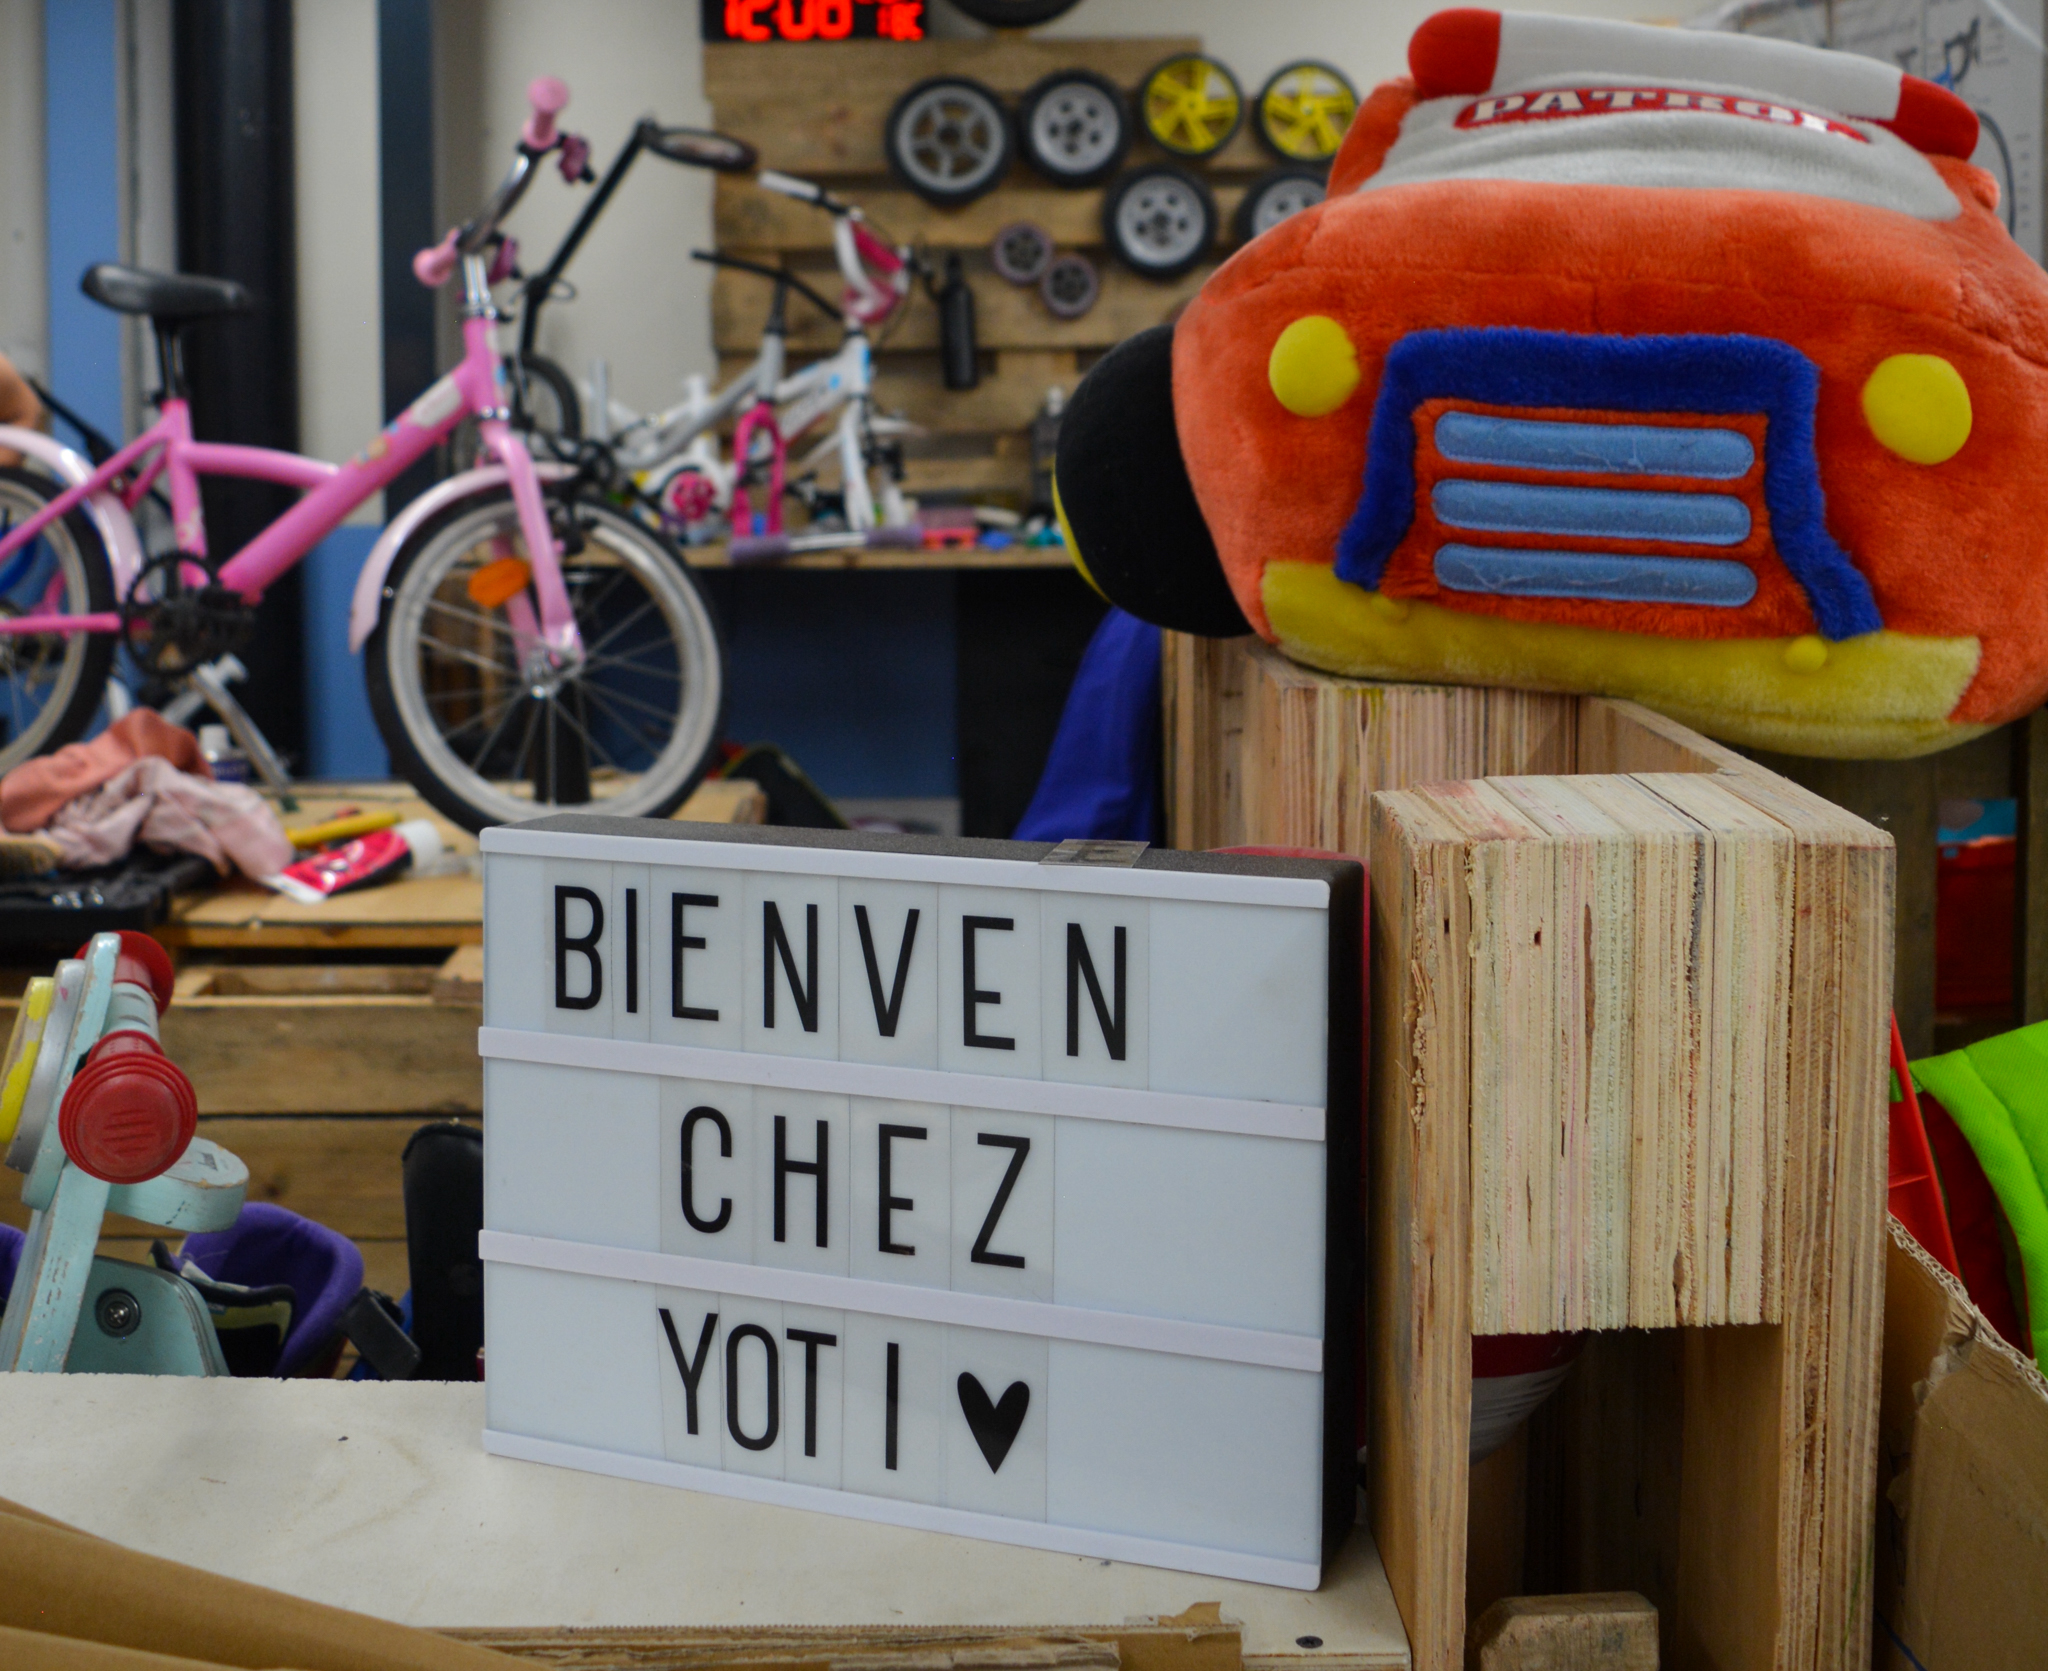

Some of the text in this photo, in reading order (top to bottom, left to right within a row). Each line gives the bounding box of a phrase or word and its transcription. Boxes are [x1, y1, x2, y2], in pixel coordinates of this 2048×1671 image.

[554, 884, 1127, 1061] BIENVEN
[680, 1105, 1031, 1270] CHEZ
[658, 1307, 900, 1471] YOTI
